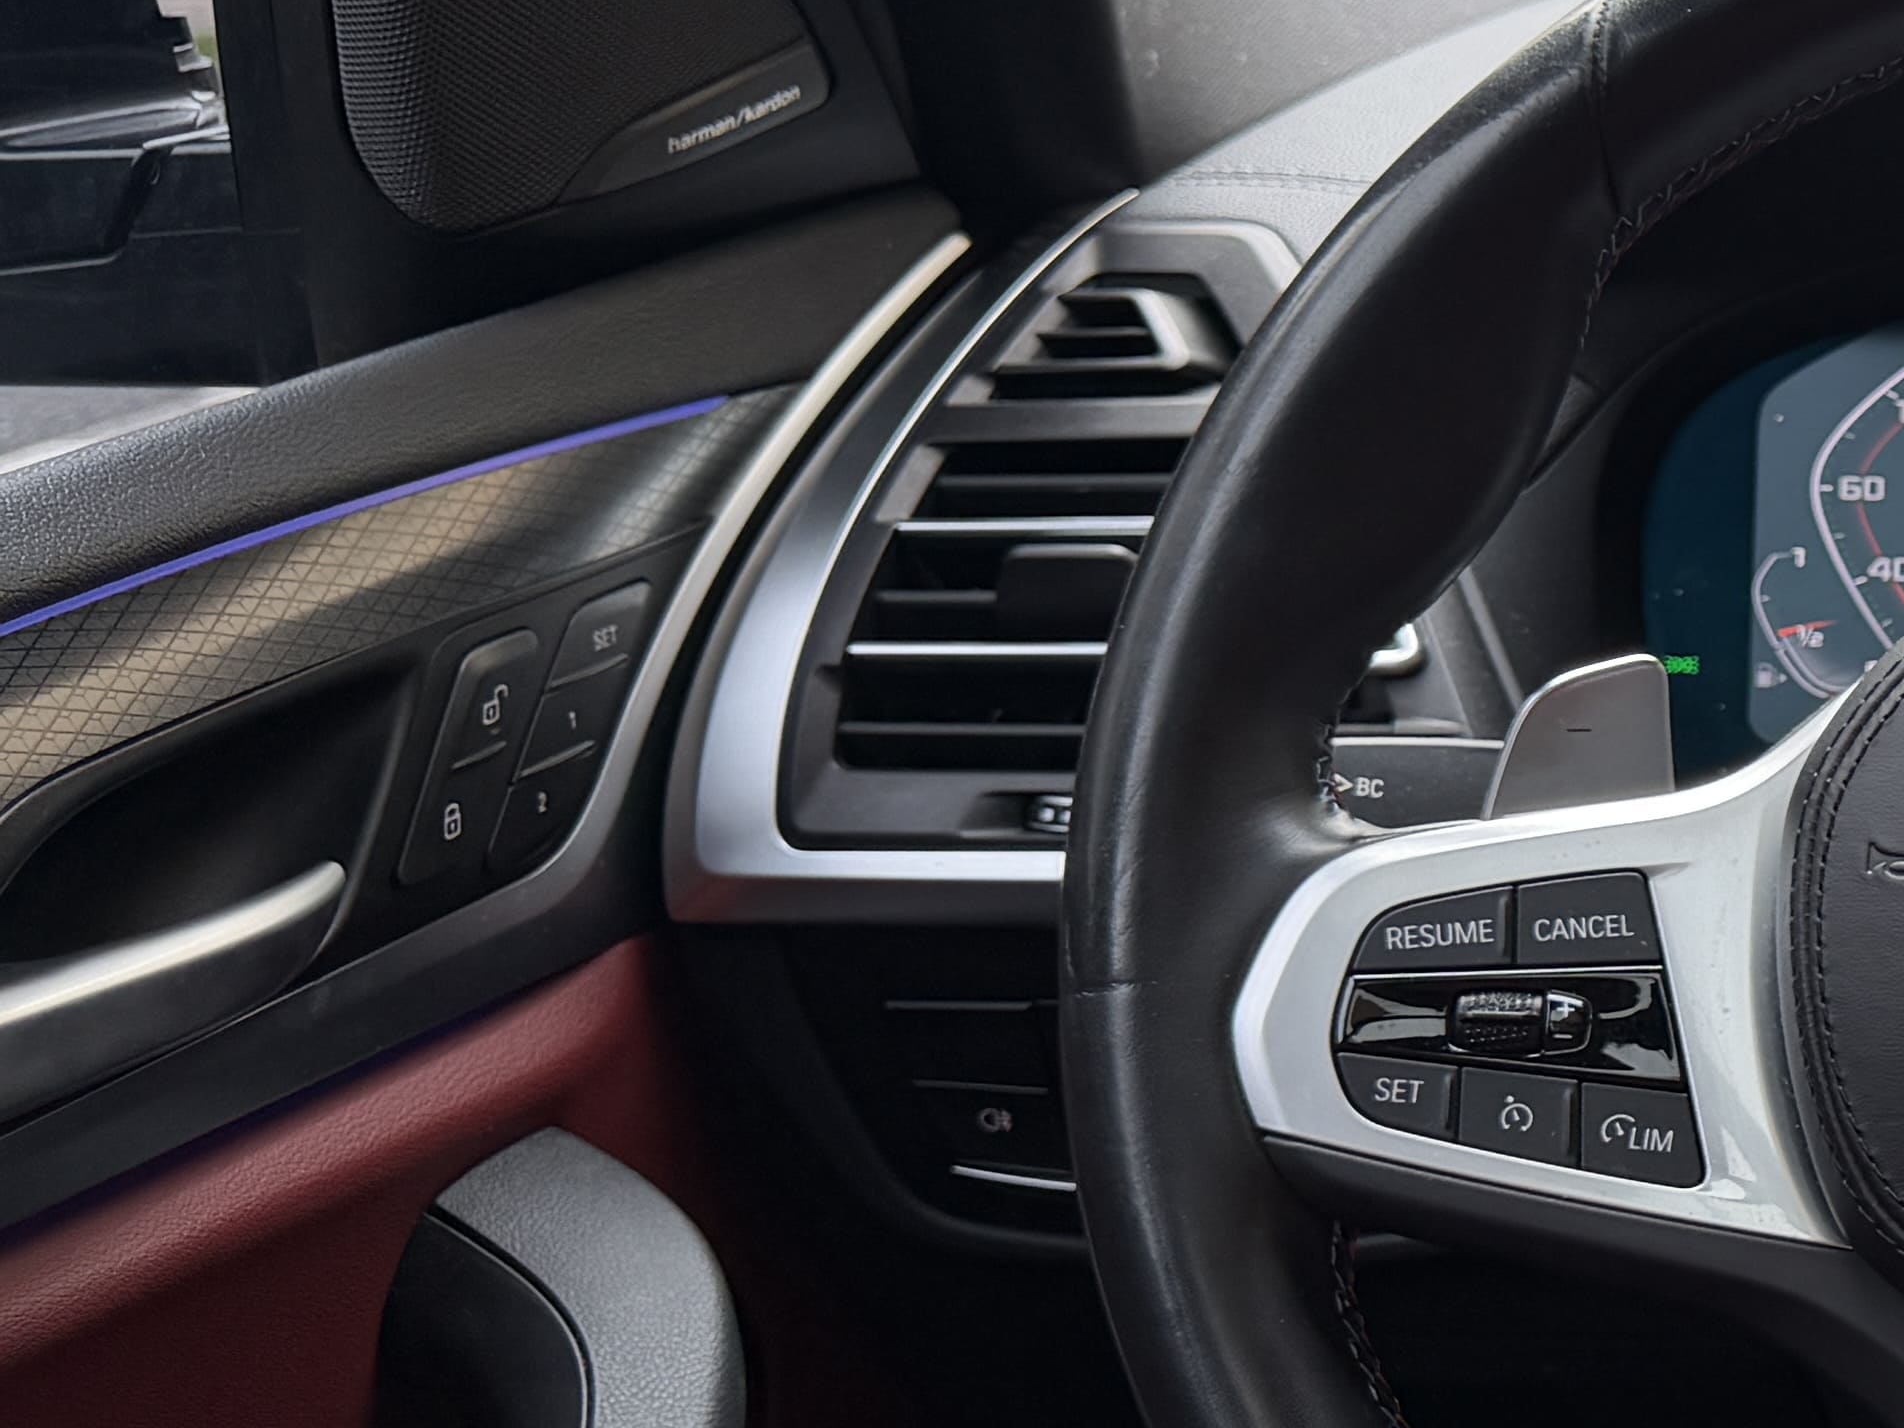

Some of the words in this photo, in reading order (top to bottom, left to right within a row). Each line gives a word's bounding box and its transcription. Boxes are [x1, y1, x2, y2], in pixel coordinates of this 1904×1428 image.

[667, 85, 802, 154] harman/kardon
[1837, 475, 1887, 502] 60
[1356, 777, 1385, 798] BC
[1384, 918, 1495, 951] RESUME
[1534, 915, 1635, 942] CANCEL
[1374, 1078, 1424, 1105] SET
[1628, 1126, 1675, 1152] LIM
